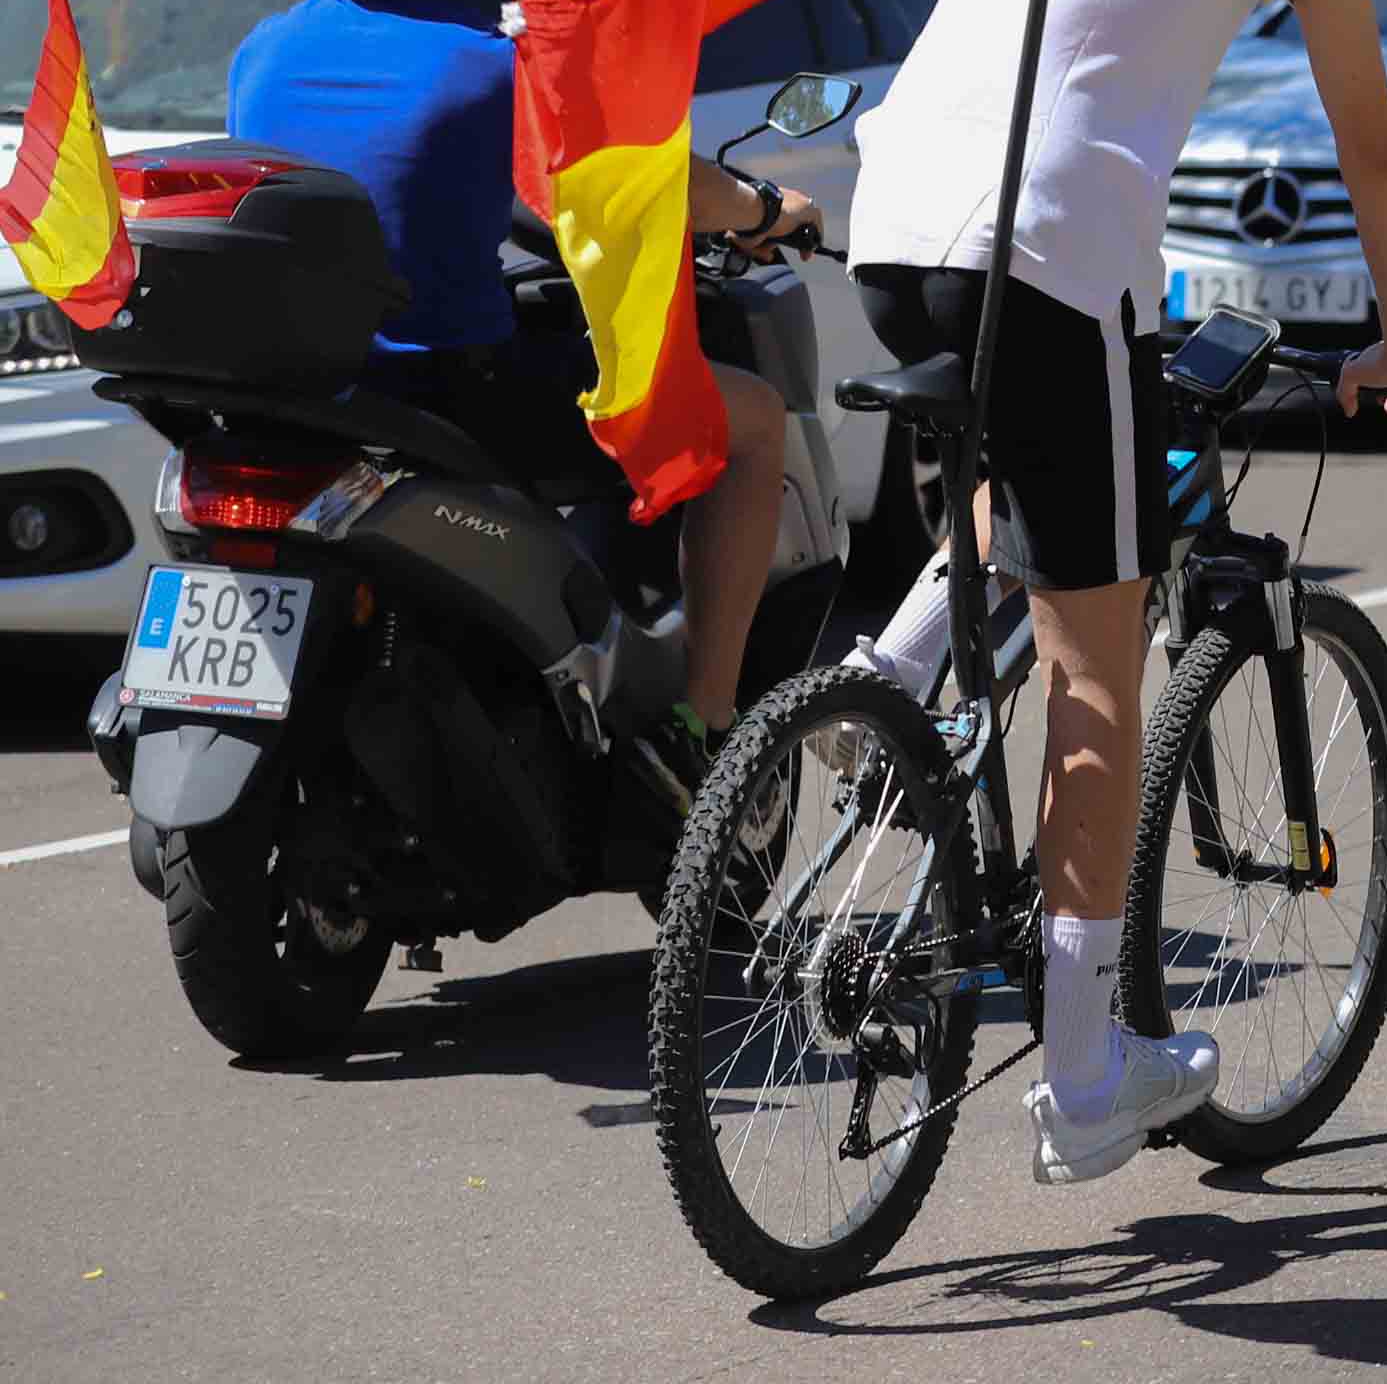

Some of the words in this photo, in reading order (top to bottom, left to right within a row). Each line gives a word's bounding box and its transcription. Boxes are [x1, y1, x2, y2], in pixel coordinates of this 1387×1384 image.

[1192, 277, 1270, 311] 1214
[1285, 276, 1360, 312] GYJ
[150, 617, 166, 636] E
[181, 581, 298, 637] 5025
[166, 634, 258, 688] KRB
